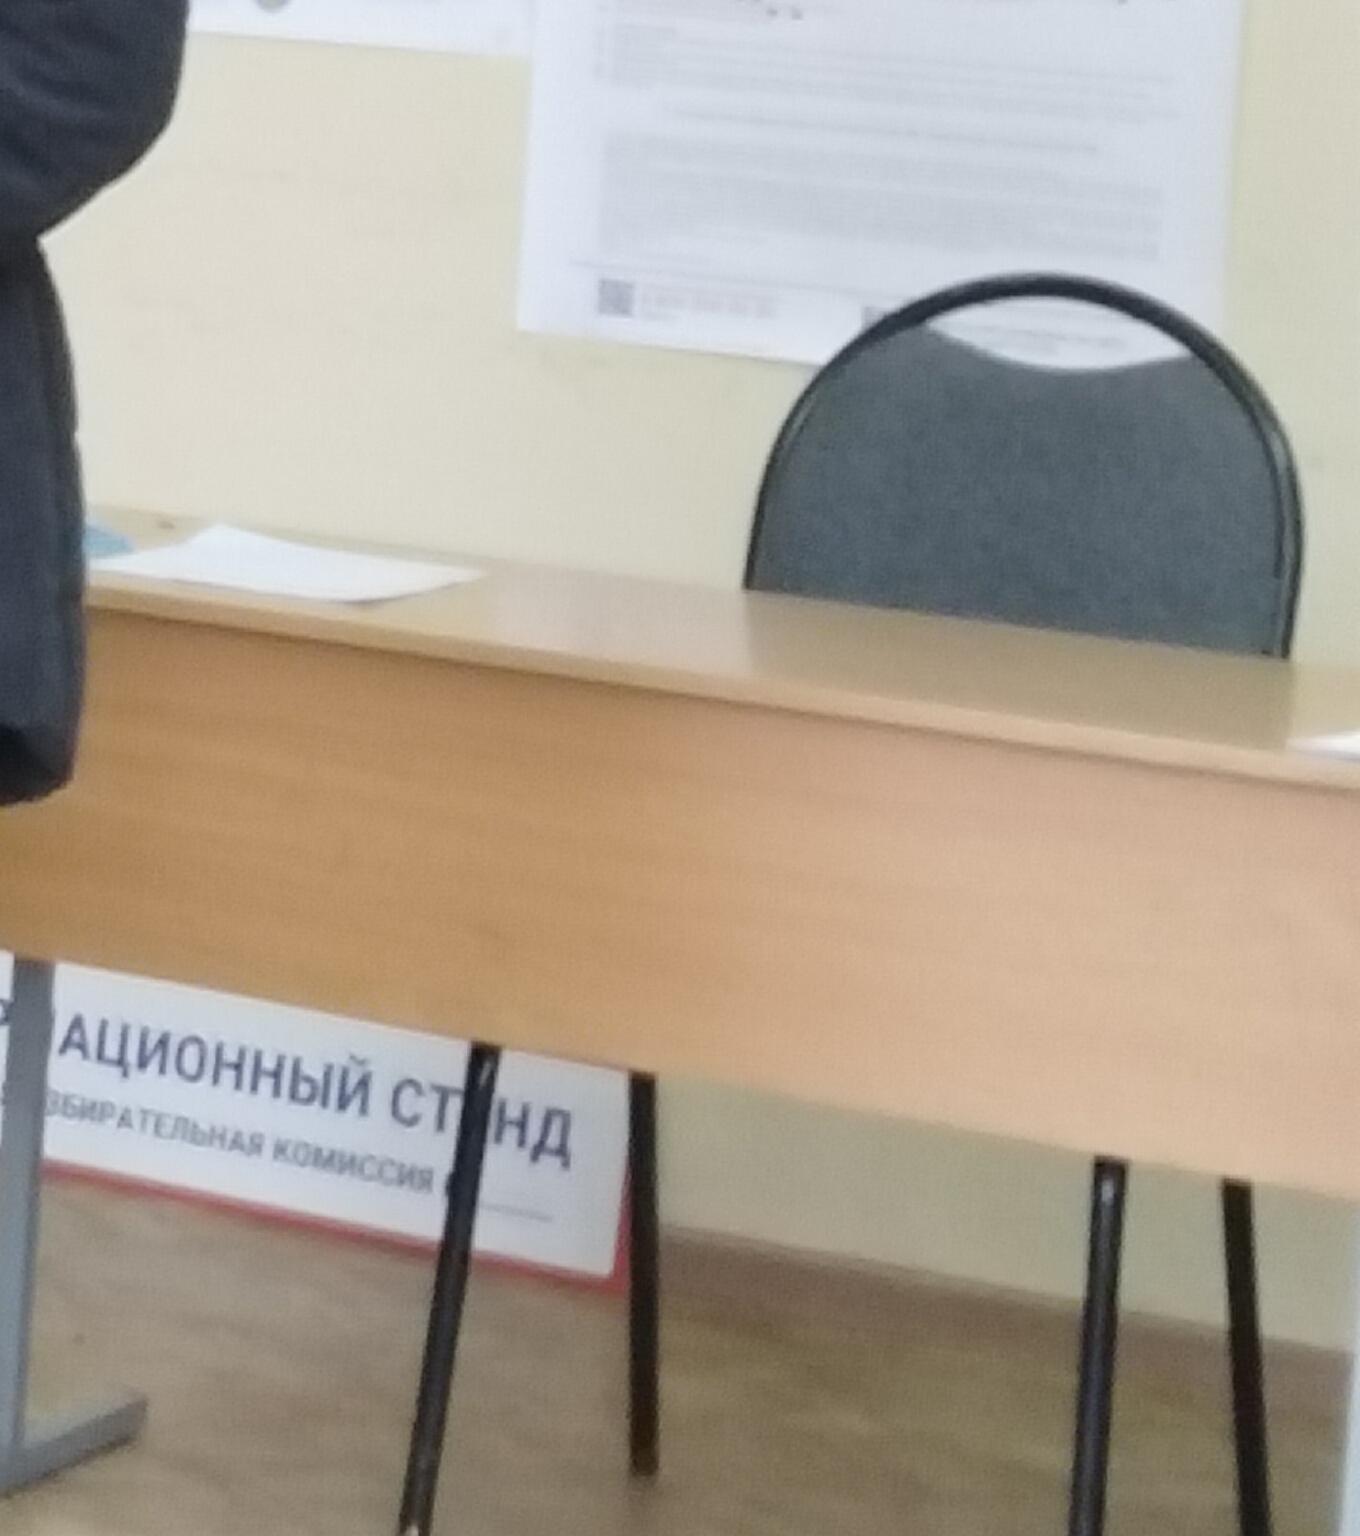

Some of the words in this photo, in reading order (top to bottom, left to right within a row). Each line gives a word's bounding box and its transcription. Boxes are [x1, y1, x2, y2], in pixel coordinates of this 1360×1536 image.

[46, 1087, 264, 1159] ЗБИРАТЕЛЬНАЯ
[271, 1134, 435, 1194] КОМИССИЯ
[390, 1077, 572, 1172] СТНД
